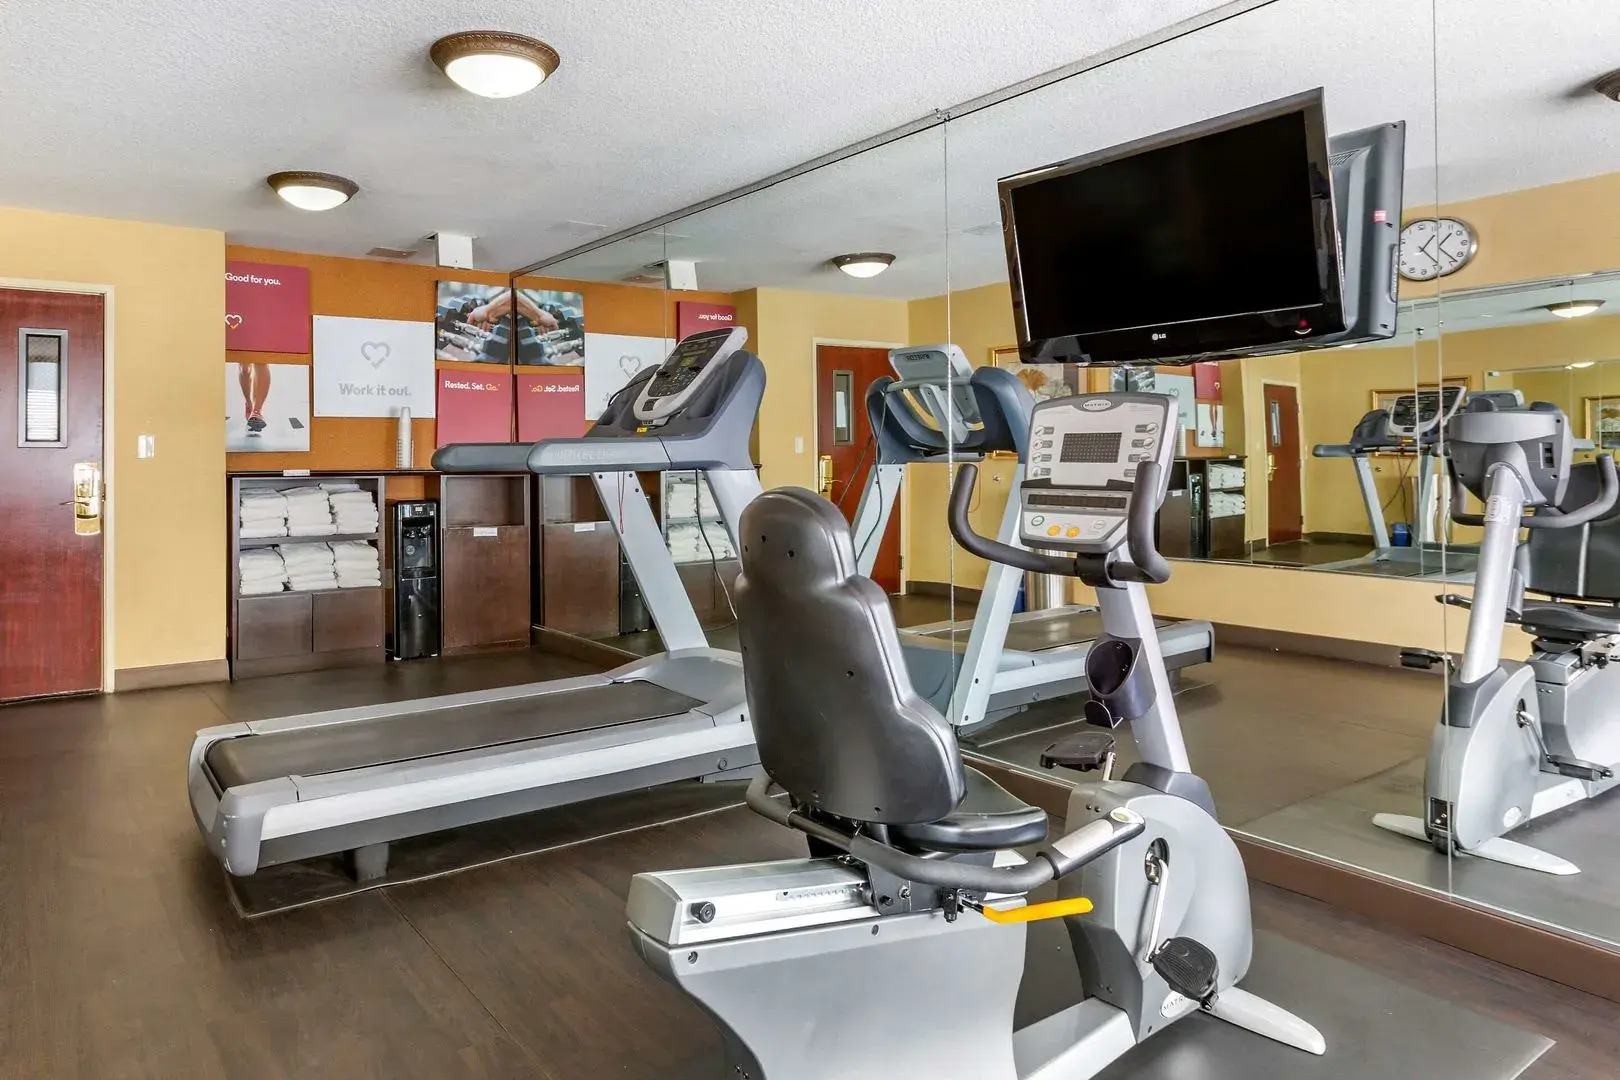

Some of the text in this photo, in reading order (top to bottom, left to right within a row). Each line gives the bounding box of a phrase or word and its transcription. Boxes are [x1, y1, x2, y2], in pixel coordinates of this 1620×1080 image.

[225, 272, 281, 286] Good for you.
[338, 383, 412, 397] Work it out.
[445, 380, 498, 391] Rested. Set. Go.
